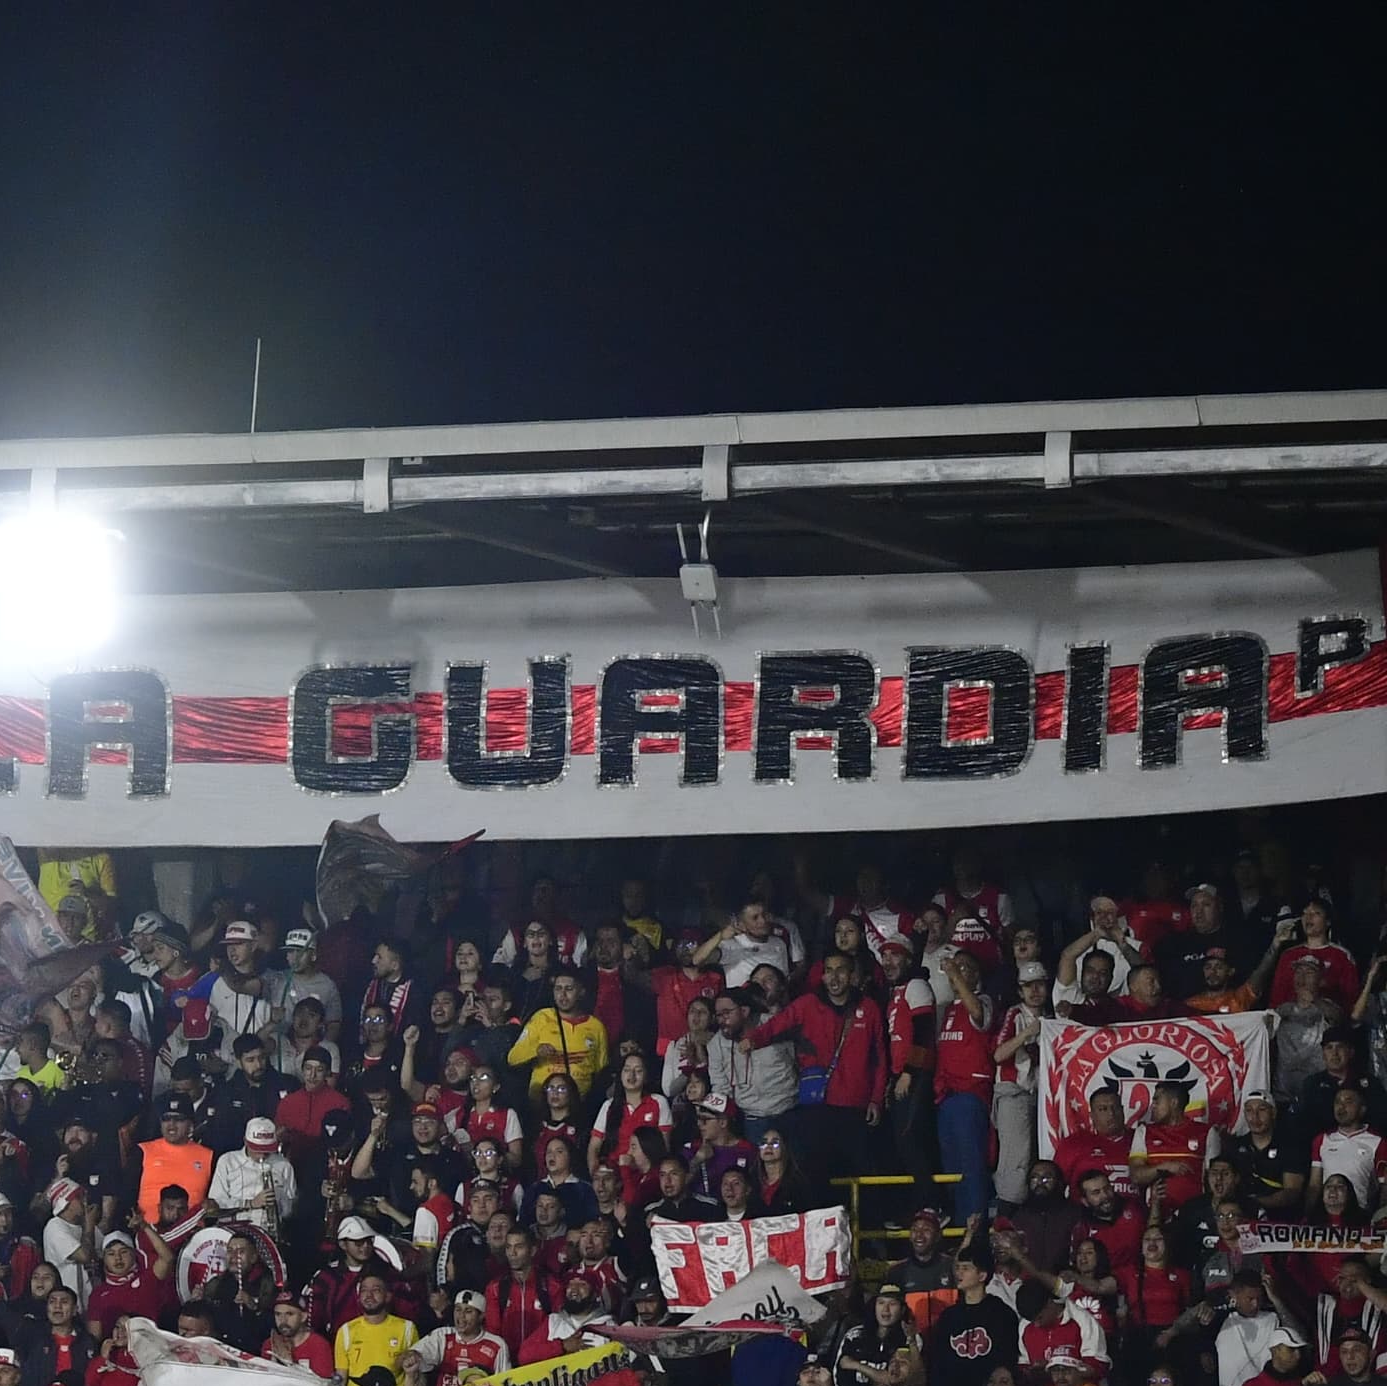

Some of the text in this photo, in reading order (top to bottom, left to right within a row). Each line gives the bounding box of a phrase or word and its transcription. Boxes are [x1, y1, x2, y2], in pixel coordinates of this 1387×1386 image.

[287, 629, 1270, 796] GUARDIA
[1071, 1024, 1226, 1092] LA GLORIOSA
[651, 1207, 846, 1302] FACA
